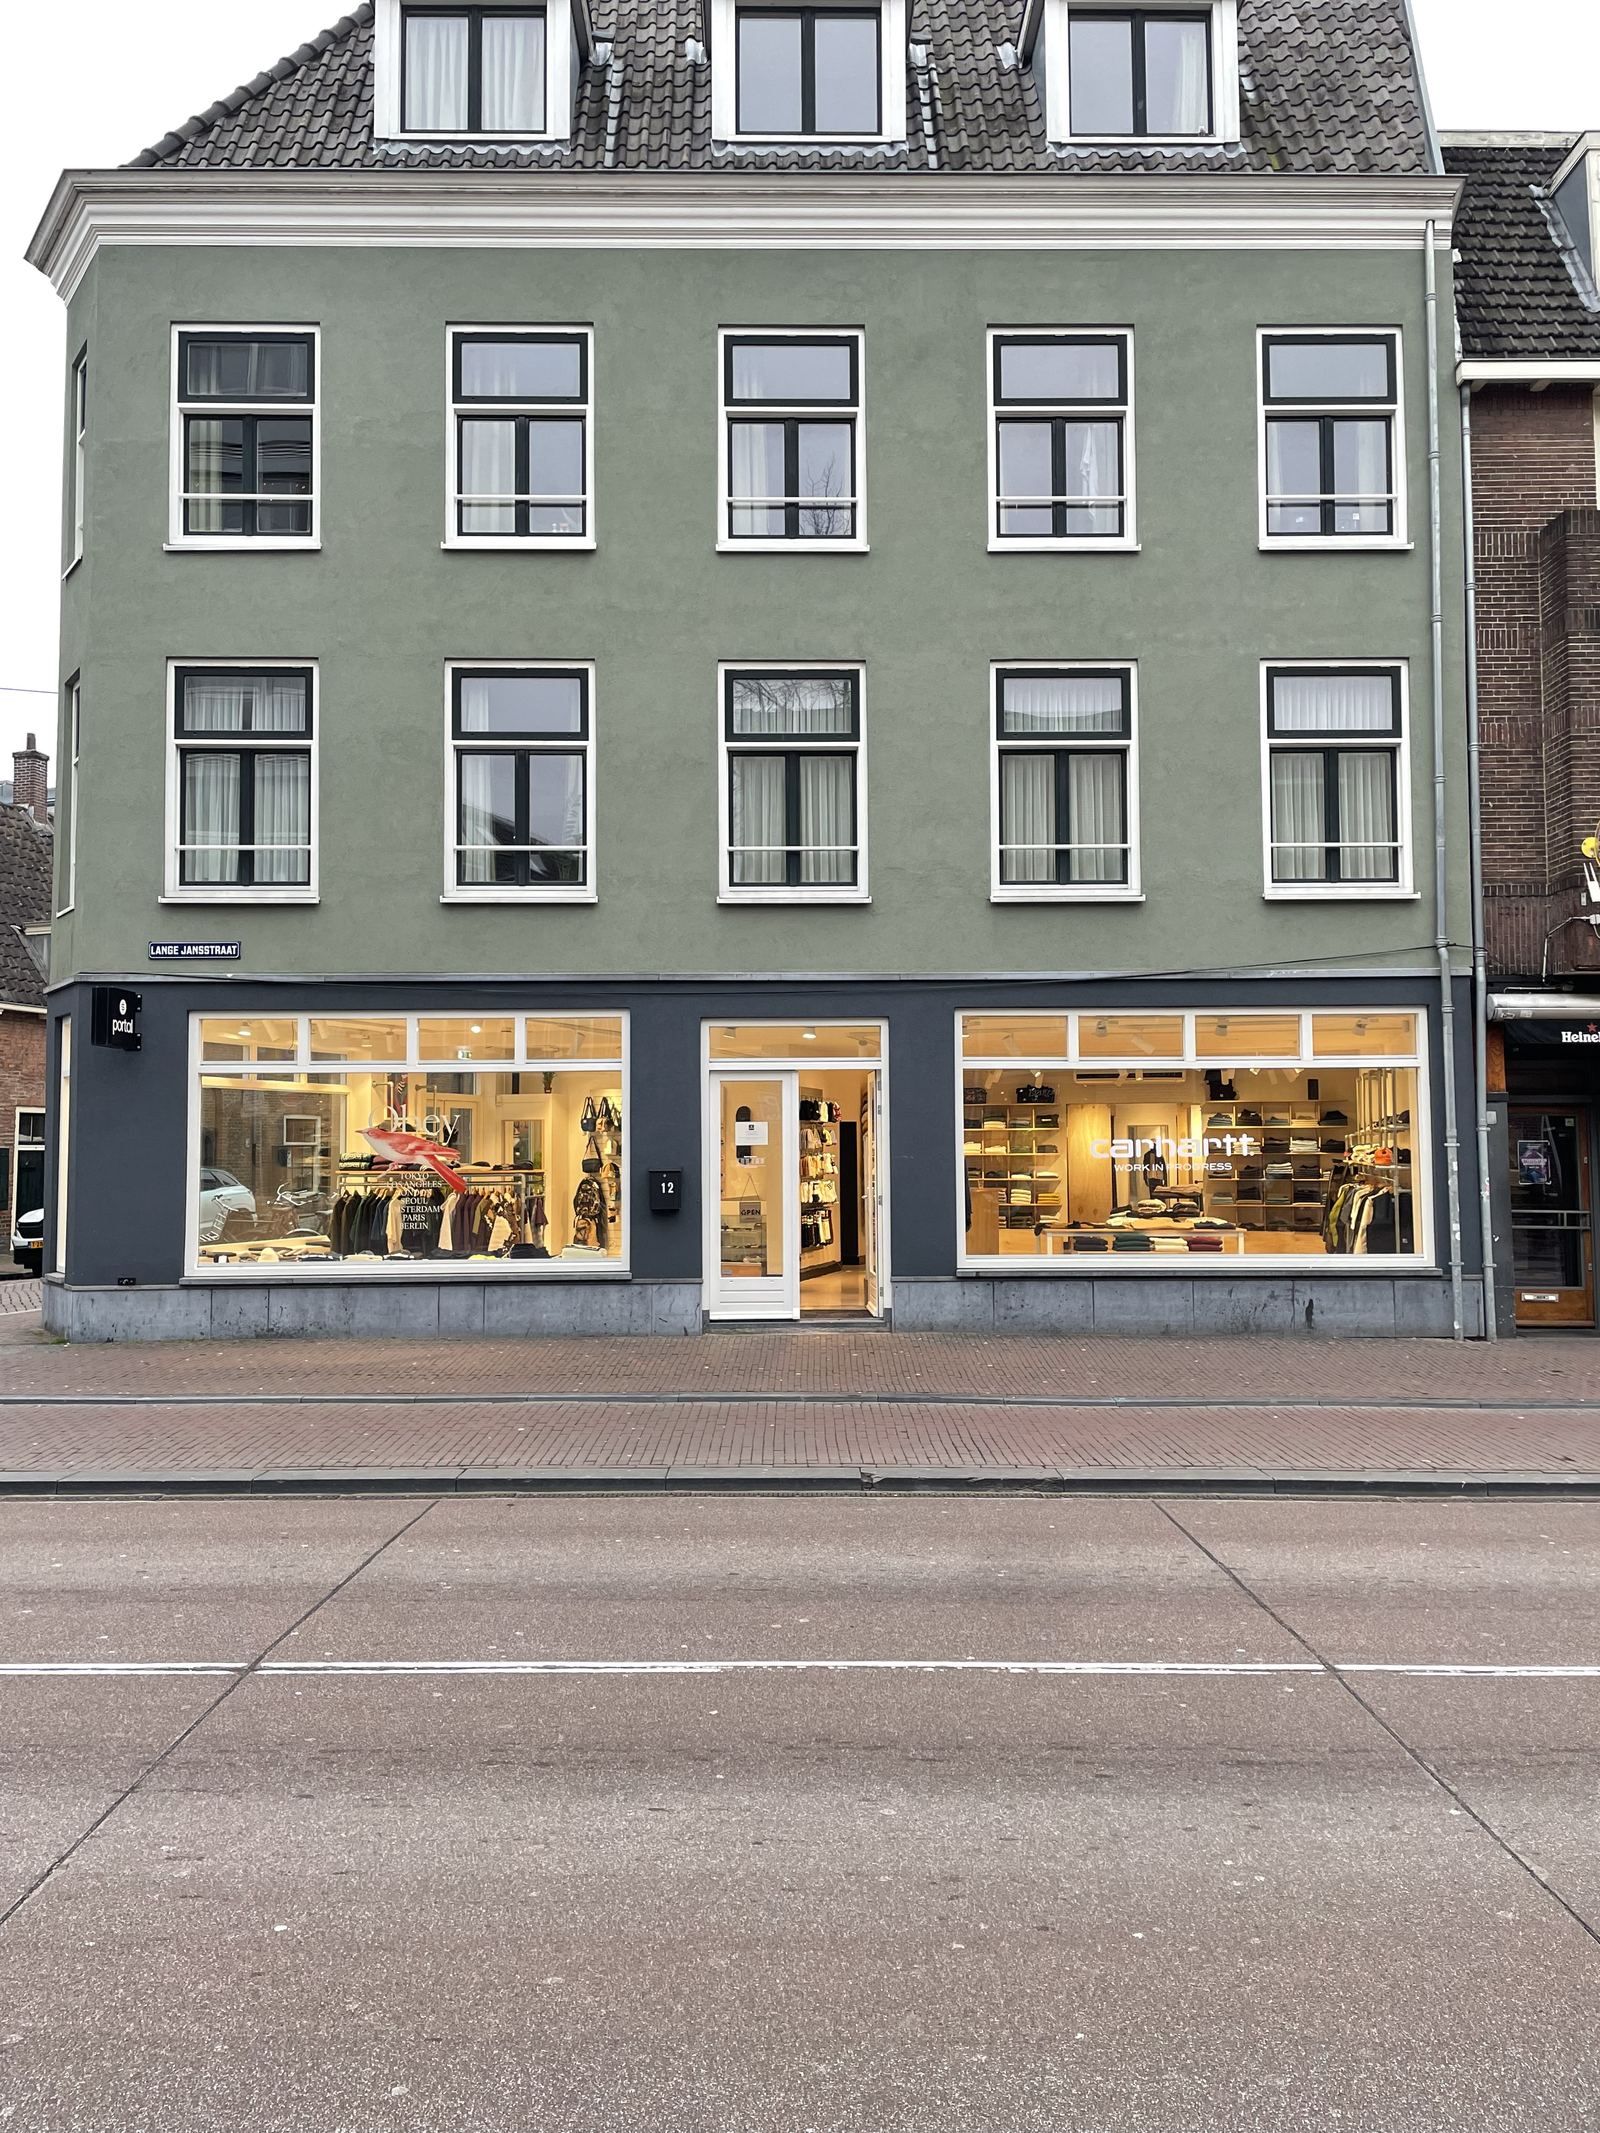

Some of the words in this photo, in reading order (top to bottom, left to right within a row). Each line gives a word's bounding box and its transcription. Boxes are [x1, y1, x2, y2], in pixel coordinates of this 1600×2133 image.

[151, 945, 179, 955] LANGE
[181, 945, 238, 955] JANSSTRAAT
[112, 1019, 134, 1035] portal
[1561, 1031, 1600, 1043] Heine
[1114, 1163, 1150, 1172] WORK
[1152, 1163, 1164, 1171] IN
[1166, 1162, 1233, 1171] PROGRESS
[401, 1172, 429, 1180] TOKYO
[661, 1182, 674, 1194] 12
[400, 1197, 428, 1205] SEOUL
[397, 1205, 441, 1213] STERDAM
[740, 1208, 761, 1216] OPEN
[403, 1213, 426, 1221] PARIS
